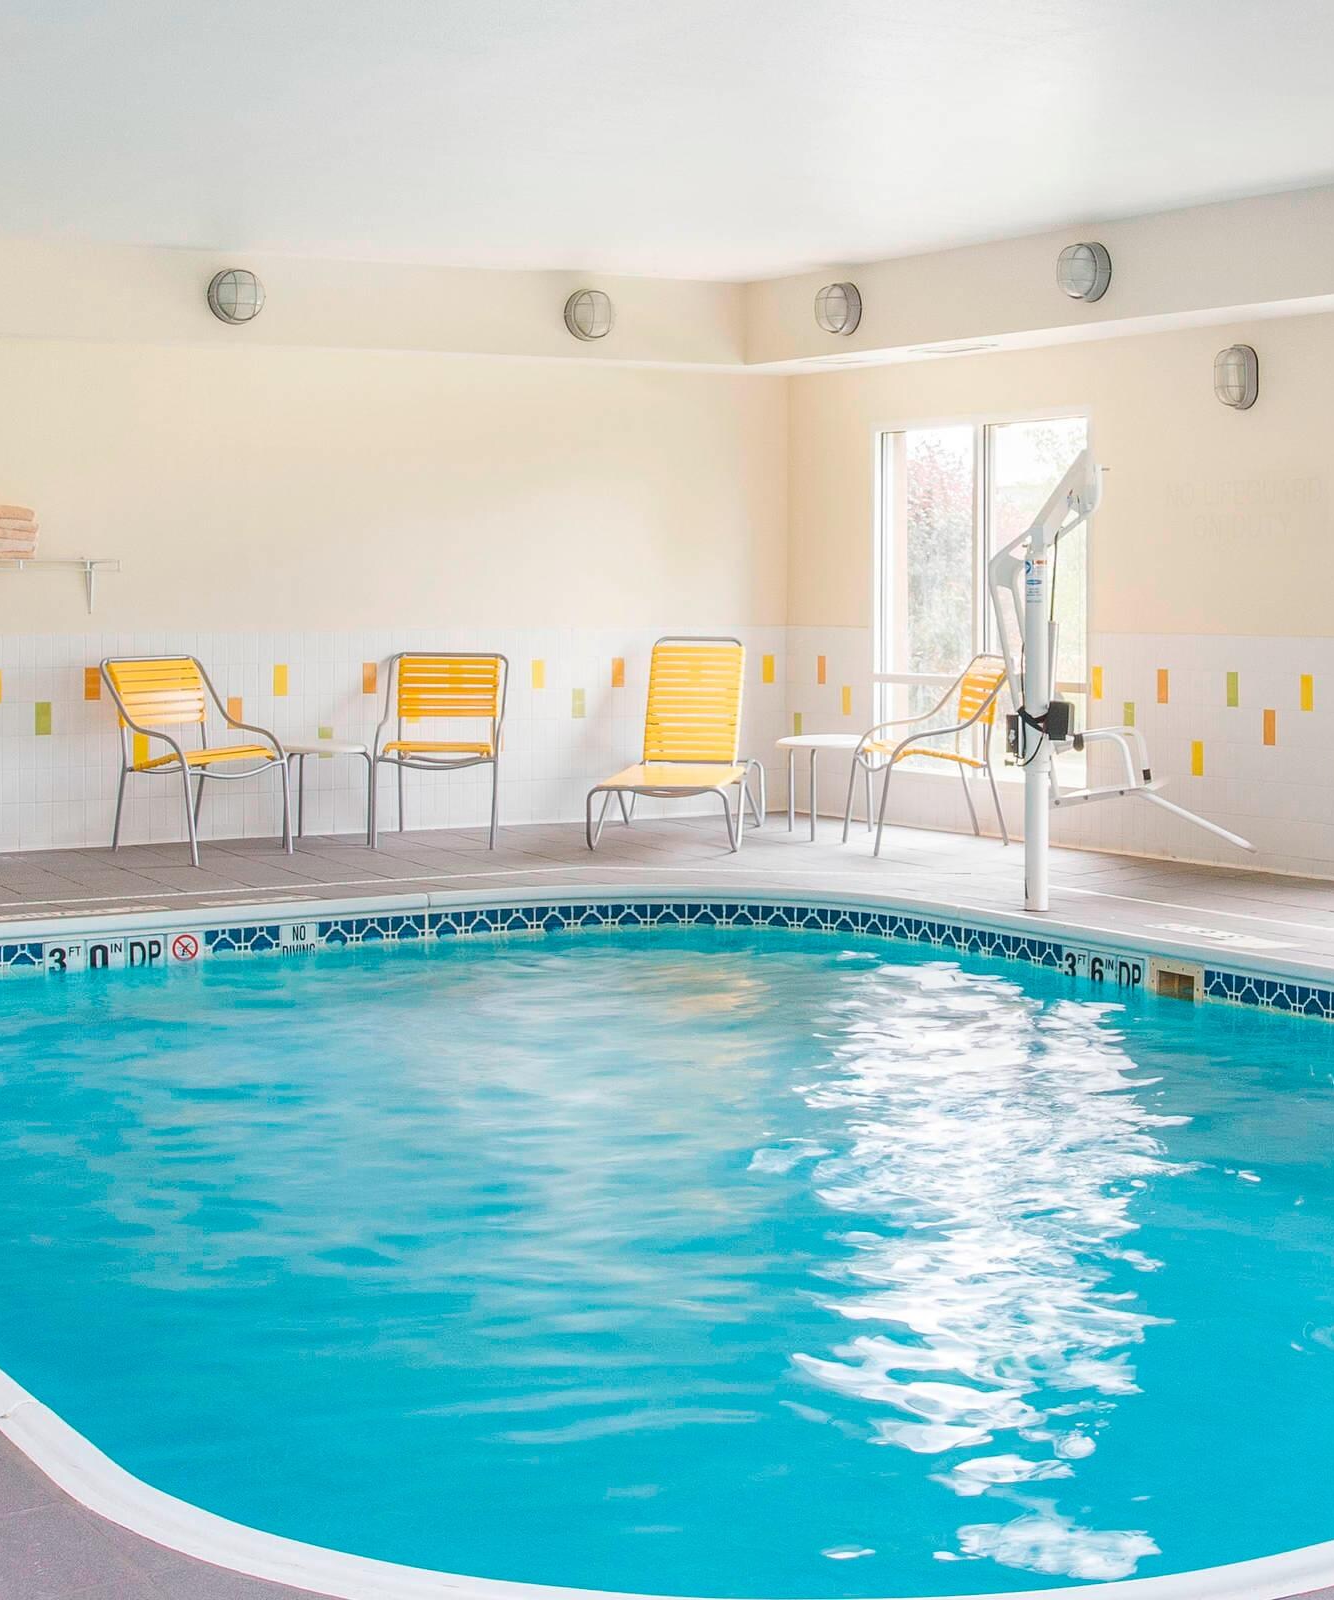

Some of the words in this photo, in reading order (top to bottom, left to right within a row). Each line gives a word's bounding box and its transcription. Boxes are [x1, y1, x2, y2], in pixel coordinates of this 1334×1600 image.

[292, 925, 306, 941] NO
[49, 948, 67, 973] 3
[68, 946, 81, 957] FT
[110, 942, 123, 953] IN
[129, 940, 162, 968] DP
[1064, 952, 1077, 976] 3
[1077, 954, 1087, 965] FT
[1091, 957, 1104, 984] 6
[1105, 959, 1114, 970] IN
[1119, 961, 1142, 991] DP
